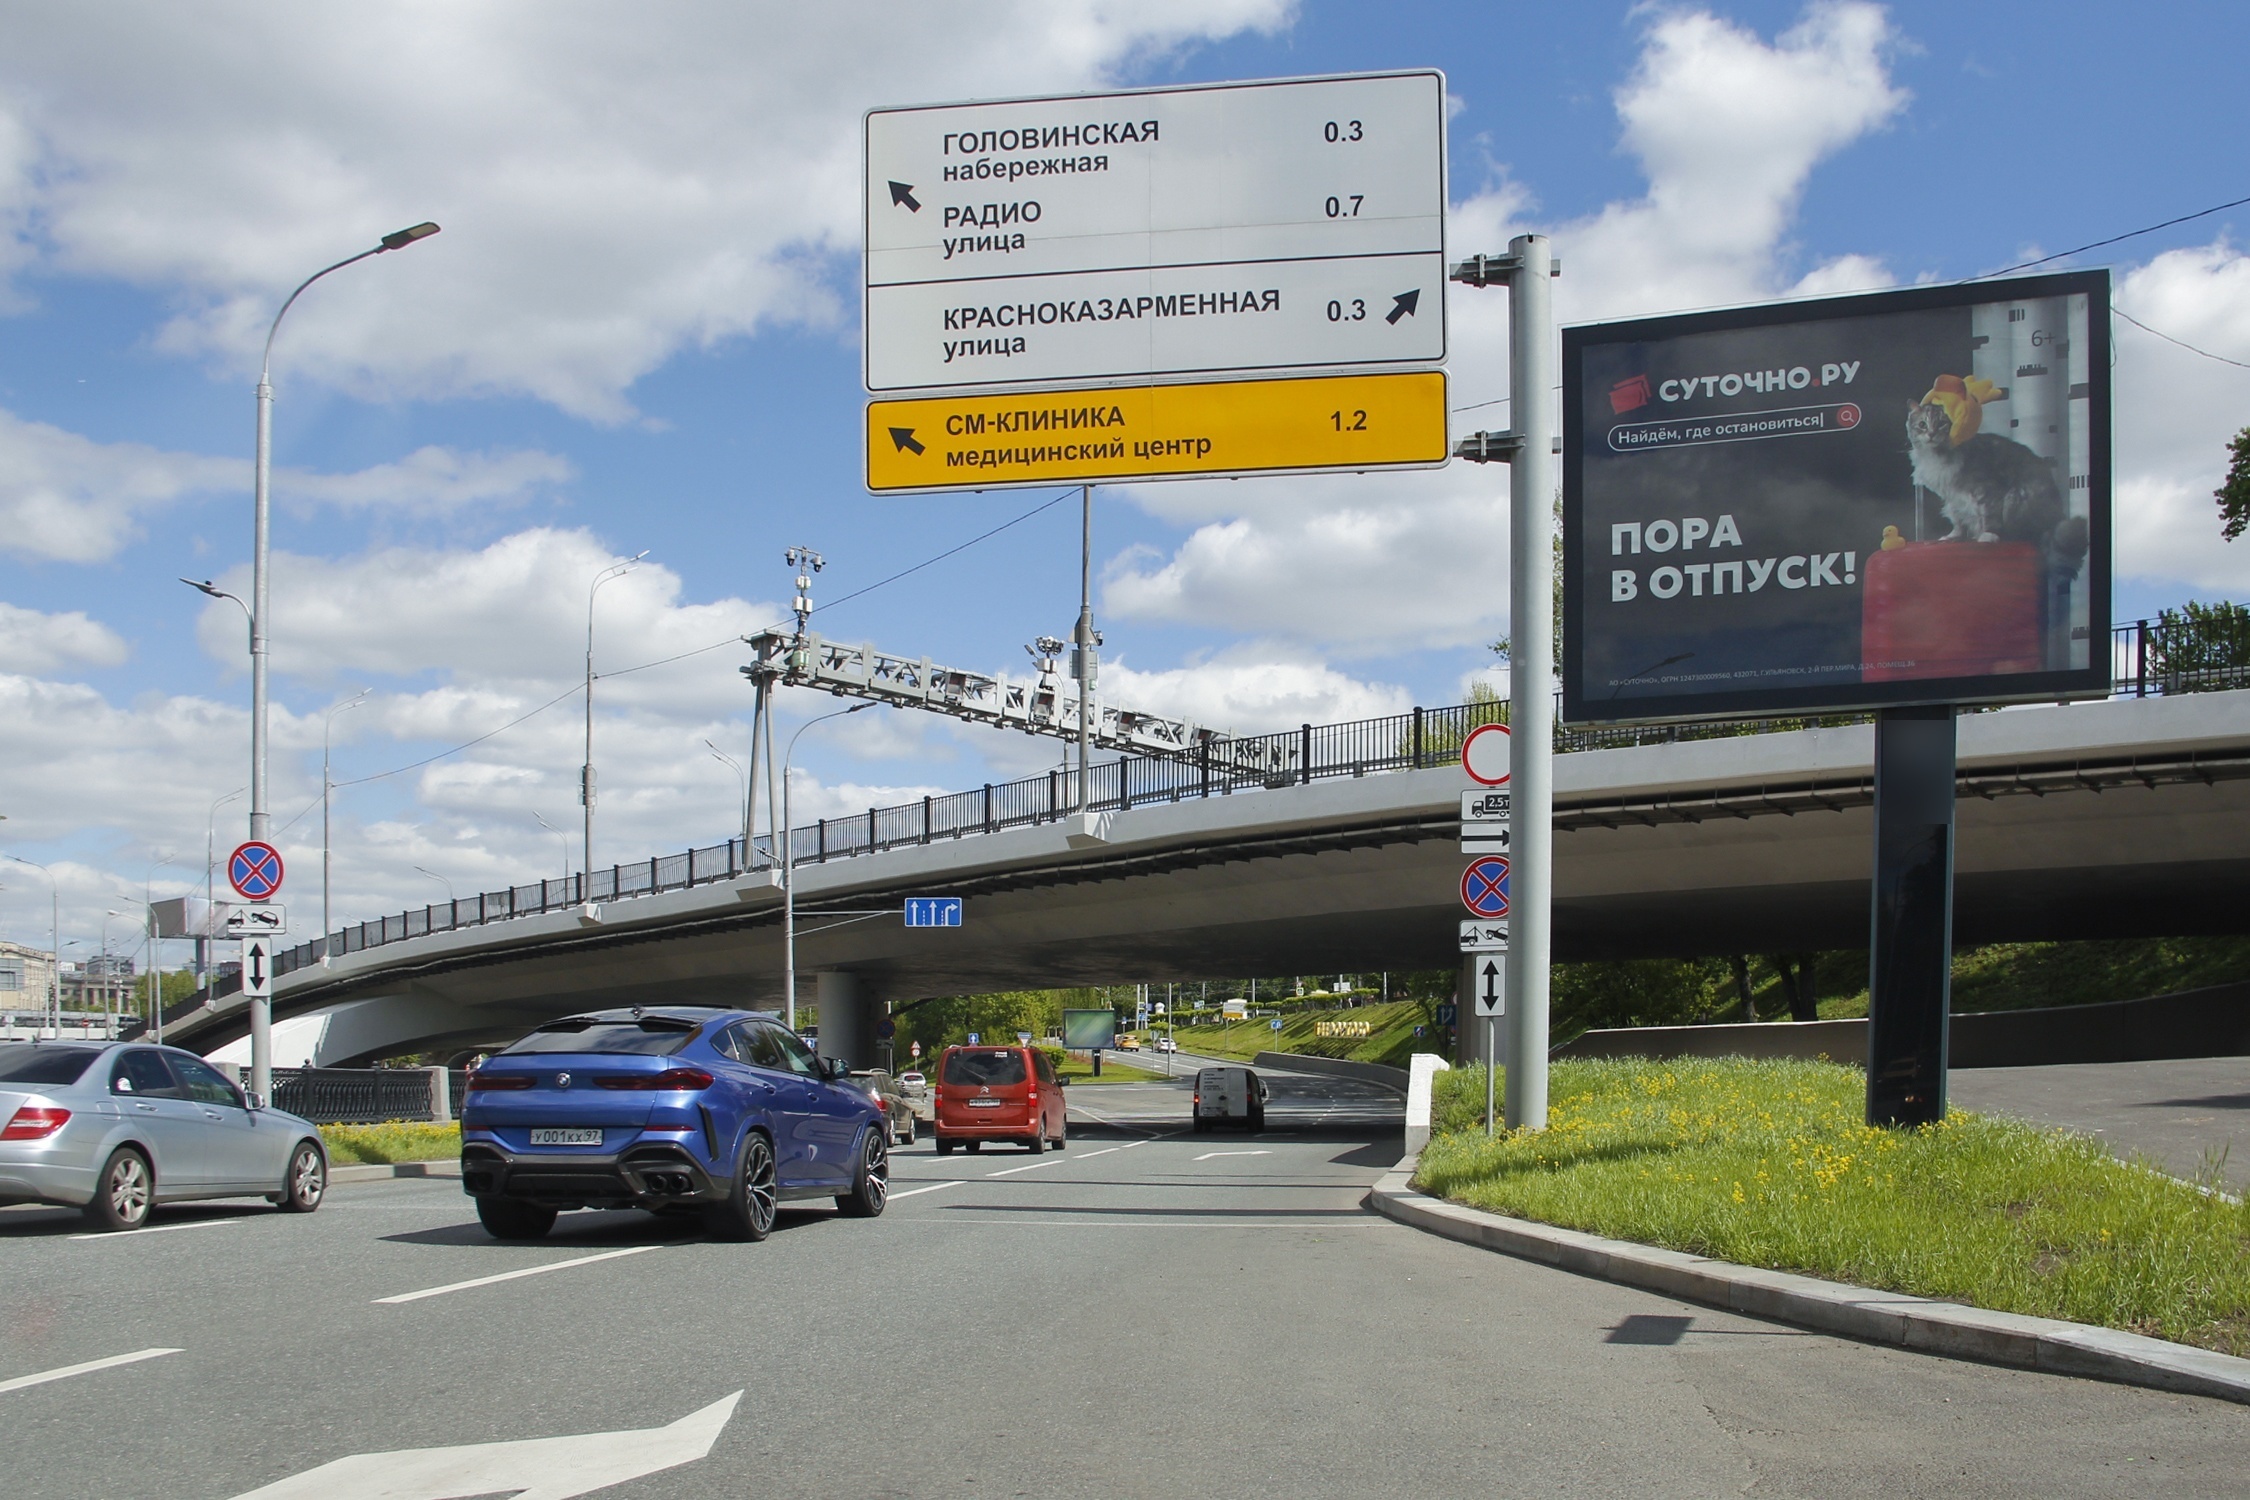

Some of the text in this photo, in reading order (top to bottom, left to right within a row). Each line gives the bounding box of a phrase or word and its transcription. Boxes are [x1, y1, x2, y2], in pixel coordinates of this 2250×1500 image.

[943, 120, 1364, 155] ГОЛОВИНСКАЯ 0.3
[943, 155, 1109, 182] набережная
[943, 195, 1365, 229] РАДИО 0.7
[942, 232, 1026, 260] улица
[943, 289, 1367, 330] КРАСНОКАЗАРМЕННАЯ 0.3
[943, 336, 1026, 363] улица
[2031, 329, 2056, 347] 6+
[1658, 360, 1861, 402] СУТОЧНО.РУ
[945, 405, 1367, 436] СМ-КЛИНИКА 1.2
[1617, 426, 1682, 445] Найдём,
[1685, 424, 1712, 440] где
[945, 436, 1212, 468] медицинский центр
[1611, 514, 1743, 556] ПОРА
[1611, 551, 1857, 603] В ОТПУСК!
